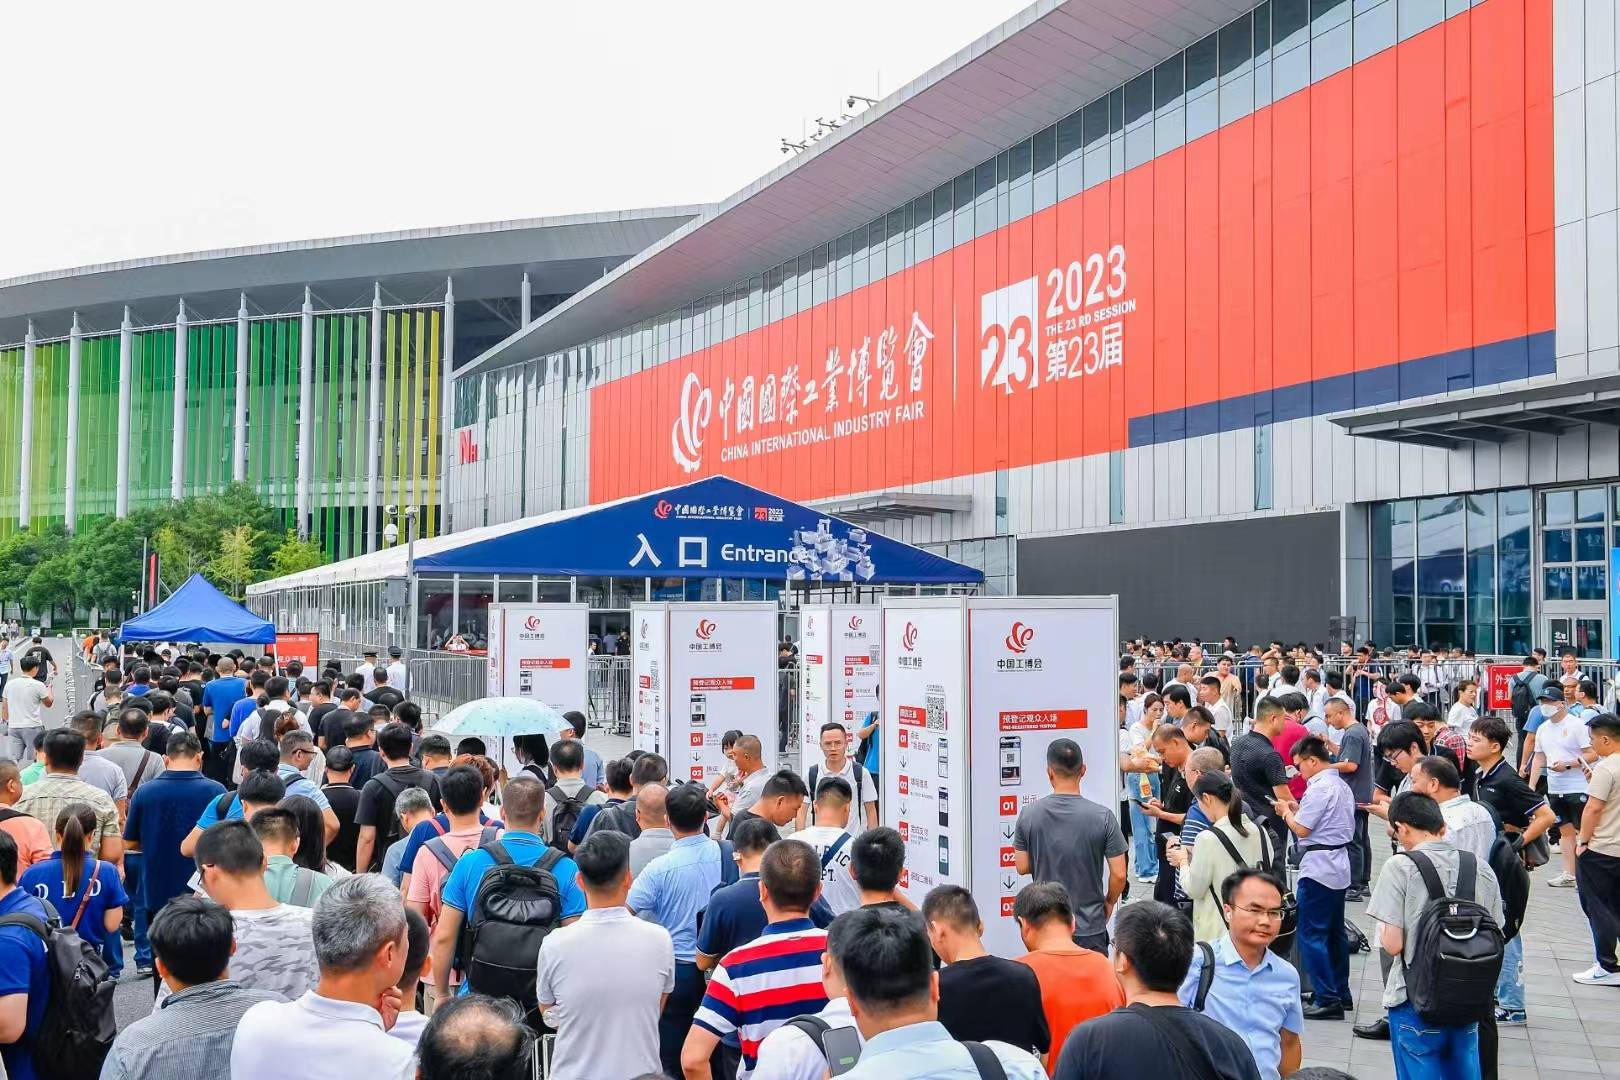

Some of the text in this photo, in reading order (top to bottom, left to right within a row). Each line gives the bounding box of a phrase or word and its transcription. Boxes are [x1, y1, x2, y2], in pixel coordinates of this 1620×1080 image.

[1045, 244, 1127, 319] 2023
[1045, 298, 1137, 337] THE 23 RD SESSION
[982, 315, 1036, 394] 23
[1045, 321, 1123, 382] 第23届
[720, 400, 925, 463] CHINA INTERNATIONAL INDUSTRY FAIR
[628, 532, 708, 568] 入口
[688, 642, 722, 651] 中国工博会
[997, 658, 1043, 669] 中国工博会
[1002, 713, 1058, 724] 预登记观众入场
[900, 780, 908, 790] 02
[1003, 802, 1014, 810] 01
[1003, 854, 1015, 863] 02
